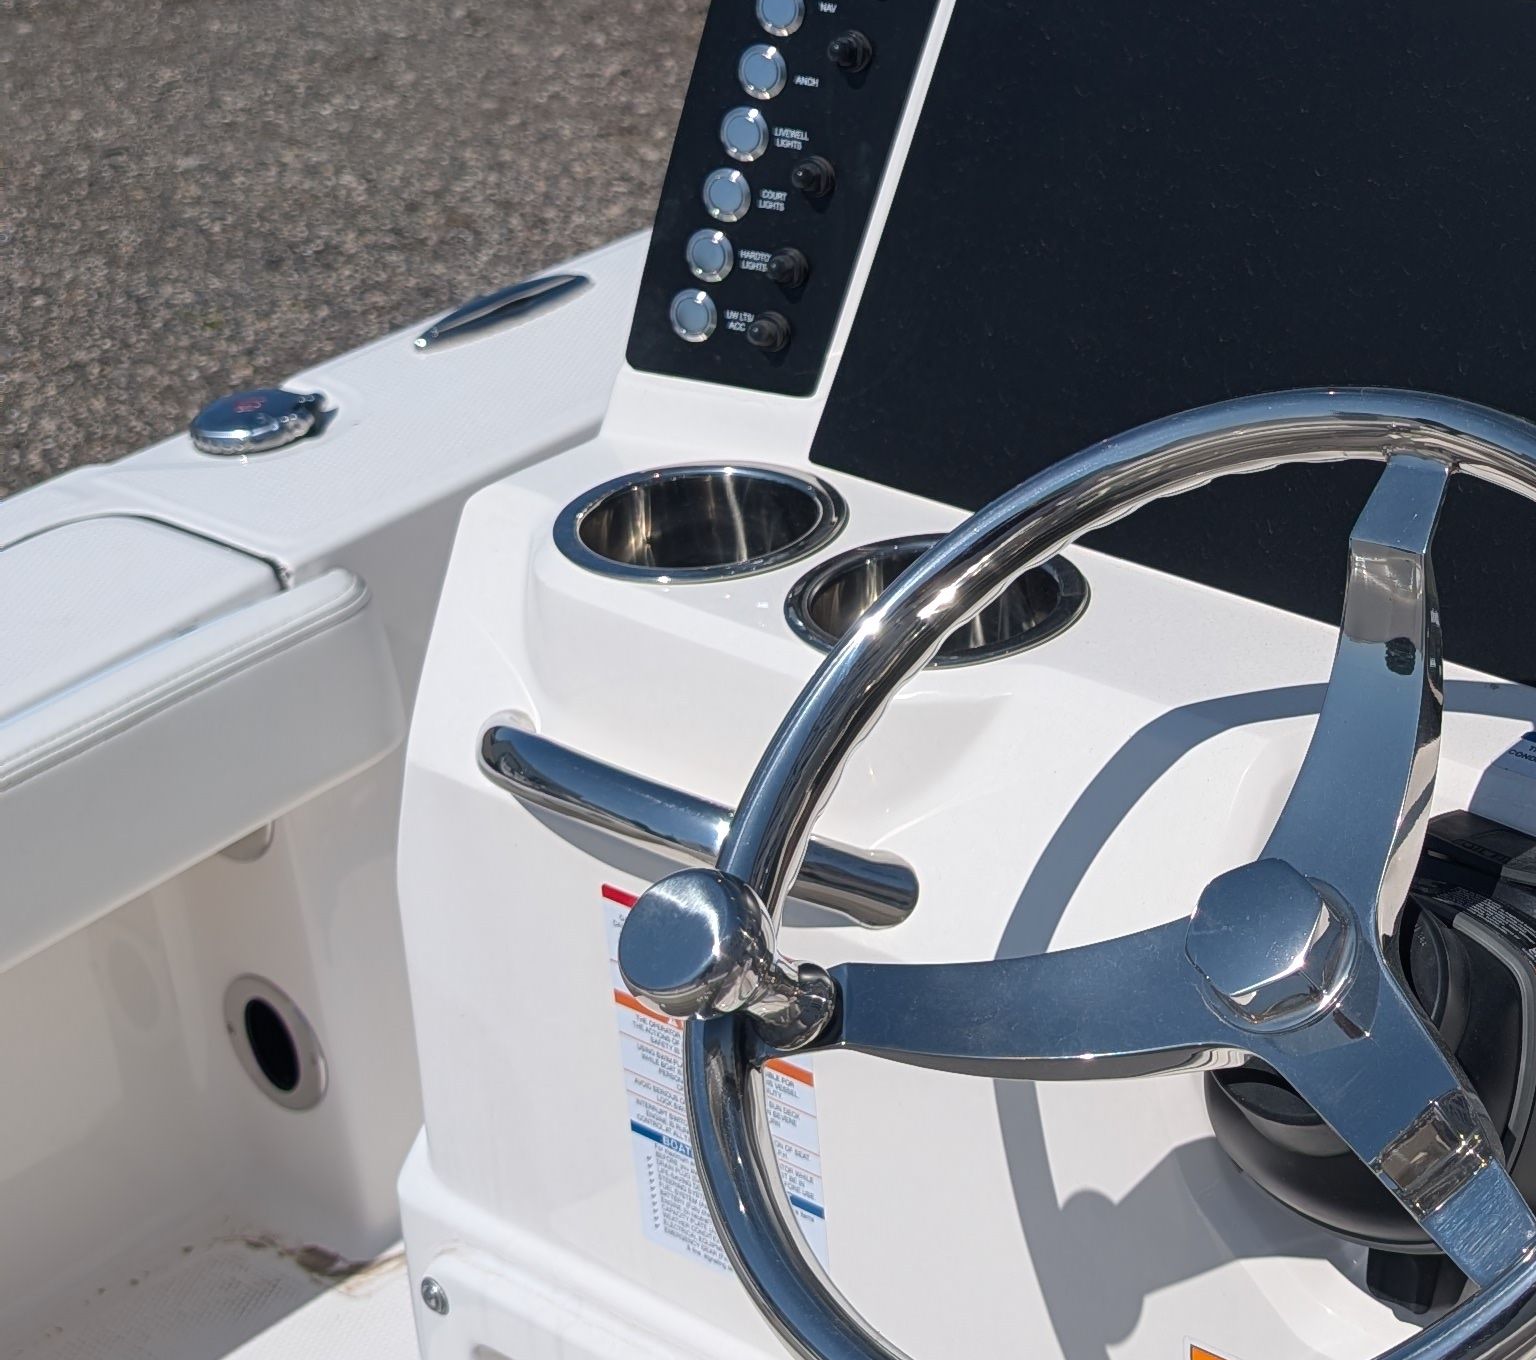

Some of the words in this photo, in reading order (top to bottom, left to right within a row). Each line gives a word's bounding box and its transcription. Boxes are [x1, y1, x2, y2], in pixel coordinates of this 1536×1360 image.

[818, 1, 837, 13] NAV
[794, 75, 819, 87] ANCH
[773, 127, 809, 141] LIVEWELL
[775, 138, 802, 150] LIGHTS
[761, 189, 787, 201] COURT
[758, 199, 785, 211] LIGHTS
[739, 249, 772, 262] HARDTO
[740, 260, 768, 272] LIGHTS
[727, 321, 746, 331] ACC
